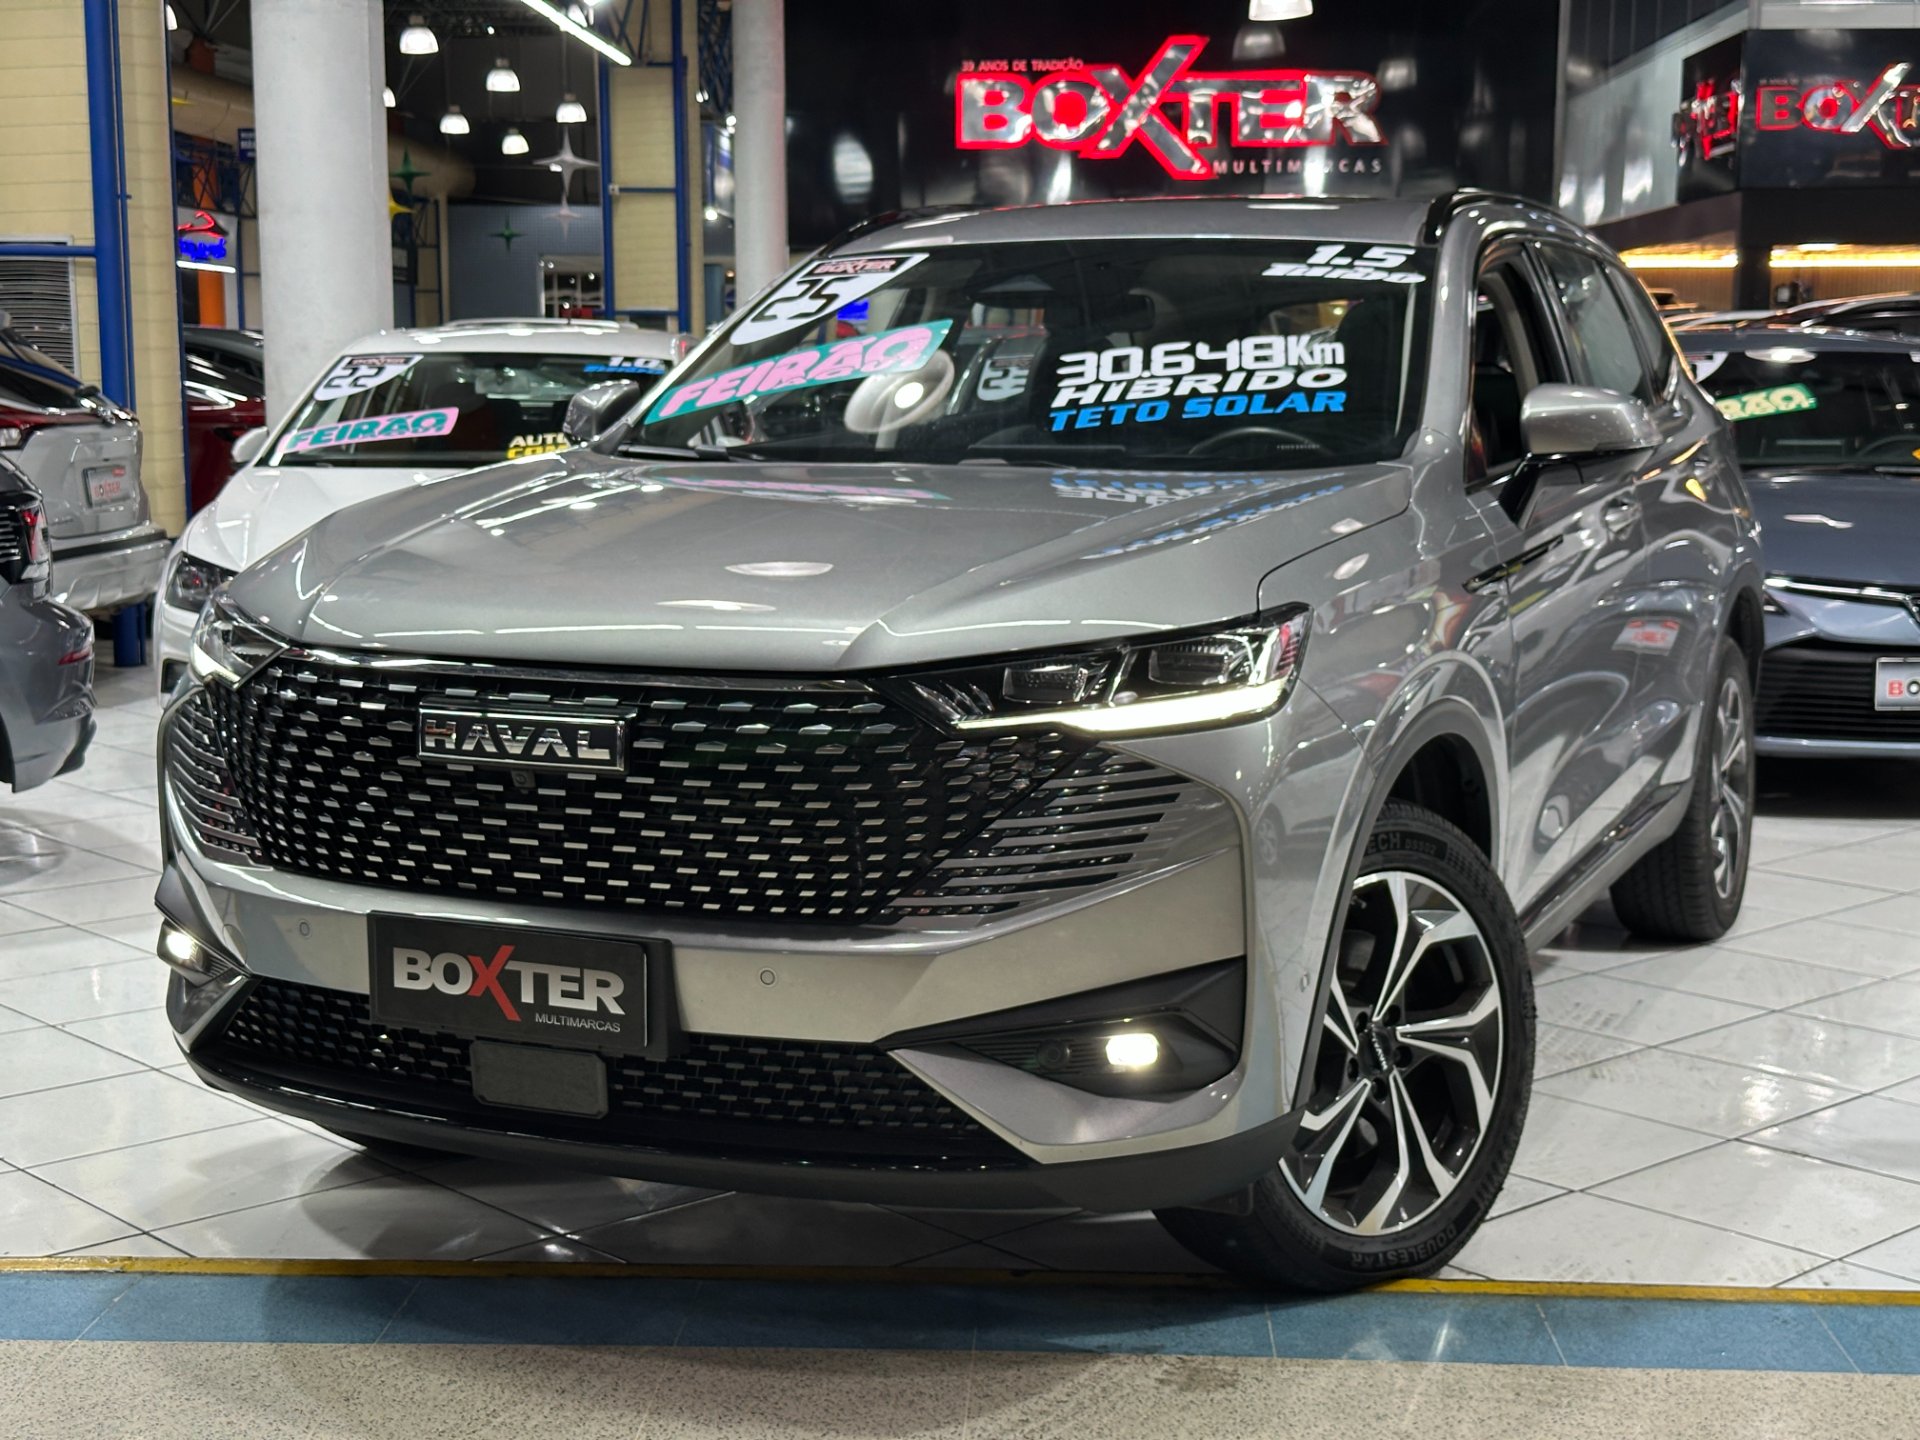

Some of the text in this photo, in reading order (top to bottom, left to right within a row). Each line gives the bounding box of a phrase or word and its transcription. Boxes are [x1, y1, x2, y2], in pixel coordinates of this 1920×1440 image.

[978, 60, 1009, 72] ANOS
[1012, 60, 1028, 72] DE
[957, 35, 1388, 179] BOXTER
[1213, 158, 1382, 175] MULTIMCAS
[1306, 243, 1417, 268] 1.5
[750, 275, 861, 324] 25
[323, 366, 386, 389] 22
[658, 326, 933, 418] FEIRÃO
[1056, 333, 1346, 388] 30.648Km
[285, 411, 448, 450] FEIRÃO
[1049, 390, 1348, 432] TETO SOLAR
[424, 718, 612, 761] HAVAL
[392, 944, 626, 1022] BOXTER
[535, 1012, 621, 1033] MULTIMARCAS
